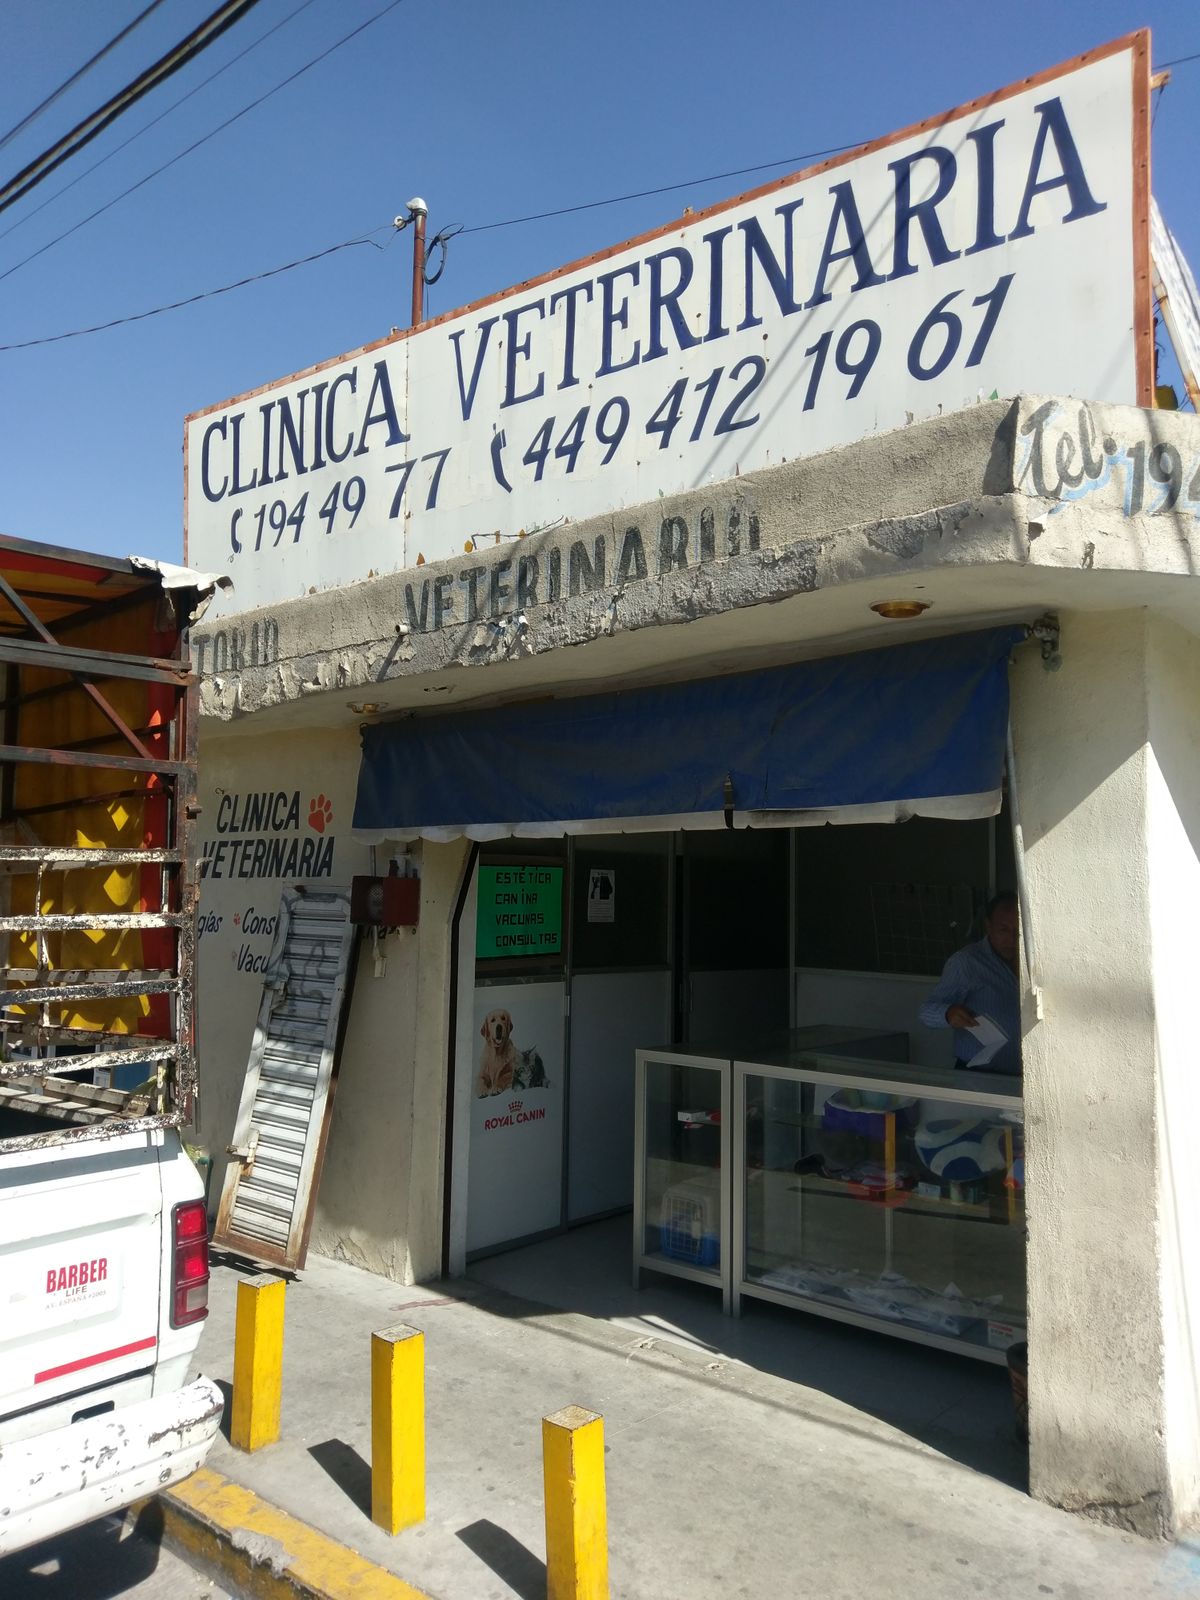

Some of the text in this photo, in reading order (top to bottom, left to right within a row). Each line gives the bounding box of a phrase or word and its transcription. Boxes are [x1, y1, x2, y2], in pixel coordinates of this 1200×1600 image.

[200, 96, 1108, 503] CLINICA VETERINARIA
[253, 272, 1017, 552] 194 49 77 449 412 19 61
[216, 790, 301, 834] CLINICA
[200, 836, 335, 879] VETERINARIA
[495, 912, 545, 926] VACUNAS
[495, 933, 558, 948] CONSULTAS
[484, 1107, 546, 1131] ROYAL CANIN
[46, 1257, 108, 1294] BARBER
[65, 1285, 88, 1298] LIFE
